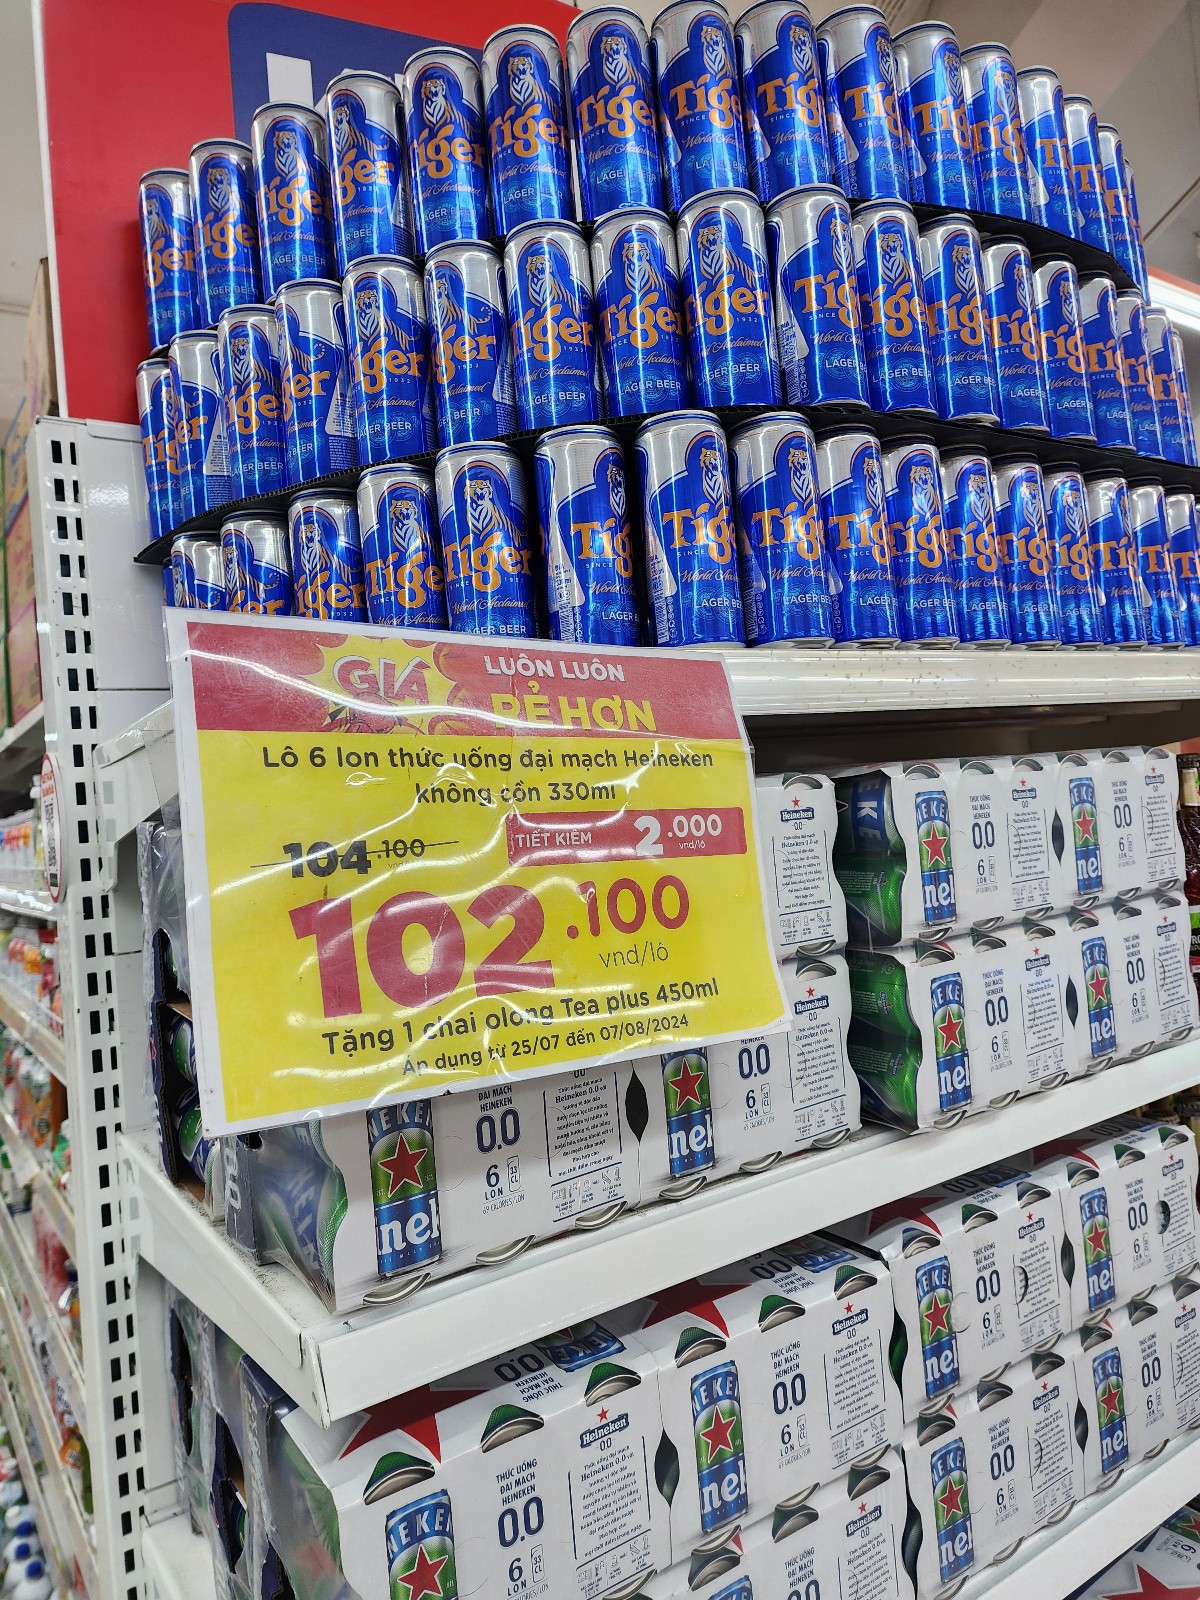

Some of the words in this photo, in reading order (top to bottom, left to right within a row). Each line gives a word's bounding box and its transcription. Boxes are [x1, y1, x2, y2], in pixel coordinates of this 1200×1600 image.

[757, 73, 824, 128] Tig
[844, 83, 901, 140] Tig
[681, 114, 707, 127] SINCE
[913, 99, 973, 149] Tig
[412, 125, 486, 179] iger
[970, 114, 1025, 164] Tig
[335, 150, 395, 204] ger
[503, 190, 535, 205] LAGER
[143, 238, 196, 287] ger
[301, 254, 326, 267] BEER
[795, 270, 859, 328] Tig
[929, 295, 989, 345] Tig
[990, 309, 1040, 360] Tig
[433, 324, 496, 384] ger
[1040, 323, 1084, 373] Tig
[353, 341, 426, 393] iger
[732, 363, 760, 374] BEER
[825, 357, 855, 368] LAGER
[872, 368, 905, 382] LAGER
[621, 380, 653, 395] LAGER
[656, 380, 681, 390] BEER
[950, 375, 982, 387] LAGER
[558, 391, 586, 402] BEER
[384, 421, 412, 432] BEER
[455, 407, 480, 421] BEER
[292, 443, 313, 457] BEER
[256, 461, 284, 472] BEER
[663, 502, 735, 563] Tig
[752, 502, 822, 560] Tig
[828, 509, 887, 564] Tig
[570, 517, 632, 577] Tig
[677, 548, 705, 557] SINCE
[950, 521, 997, 572] Tig
[1000, 526, 1050, 576] Tig
[445, 532, 532, 592] Tiger
[366, 553, 445, 609] Tige
[296, 570, 366, 619] iger
[694, 597, 728, 609] LAGER
[784, 594, 818, 605] LAGER
[860, 596, 889, 606] LAGER
[905, 599, 938, 610] LAGER
[966, 601, 997, 611] LAGER
[602, 611, 633, 621] LAGER
[1018, 603, 1050, 614] LAGER
[499, 624, 526, 635] BEER
[333, 655, 430, 702] GIÁ
[484, 654, 554, 677] LUÔN
[561, 658, 625, 682] LUÔN
[491, 681, 553, 728] RẺ
[557, 694, 657, 731] HƠN
[262, 746, 299, 767] Lô
[309, 746, 326, 767] 6
[337, 746, 379, 767] lon
[387, 746, 444, 767] thức
[453, 746, 512, 771] uống
[519, 749, 553, 772] đại
[561, 750, 618, 771] mạch
[624, 750, 713, 767] Heineken
[415, 782, 492, 807] không
[500, 779, 541, 803] cồn
[549, 781, 616, 801] 330ml
[782, 809, 814, 821] Heineken
[1113, 803, 1133, 829] 0.0
[515, 828, 551, 848] TIẾT
[971, 821, 996, 851] 0.0
[1118, 836, 1126, 851] 6
[977, 859, 985, 876] 6
[599, 941, 670, 969] vnd/lô
[1126, 957, 1145, 985] 0.0
[322, 1028, 394, 1058] Tặng
[402, 1020, 413, 1042] 1
[423, 1011, 477, 1040] chai
[485, 1004, 554, 1029] olong
[560, 998, 599, 1018] Tea
[606, 990, 650, 1015] plus
[656, 977, 719, 1003] 450ml
[795, 998, 828, 1013] Heineken
[985, 995, 1009, 1027] 0.0
[402, 1055, 429, 1076] Áp
[434, 1049, 483, 1071] dụng
[488, 1043, 506, 1060] từ
[511, 1033, 559, 1057] 25/07
[565, 1027, 596, 1048] đến
[600, 1013, 689, 1042] 07/08/2024
[991, 1036, 999, 1052] 6
[737, 1043, 771, 1079] 0.0
[480, 1096, 513, 1113] HEINEKEN
[745, 1089, 756, 1109] 6
[744, 1109, 759, 1120] LON
[476, 1107, 521, 1153] 0.0
[485, 1164, 500, 1188] 6
[510, 1165, 518, 1175] 33
[511, 1175, 519, 1184] CL
[484, 1186, 504, 1201] LON
[976, 1269, 1001, 1304] 0.0
[833, 1310, 868, 1333] Heineken
[982, 1311, 991, 1329] 6
[773, 1373, 807, 1415] 0.0
[583, 1416, 627, 1446] Heineken
[781, 1423, 792, 1445] 6
[780, 1443, 795, 1457] LON
[990, 1444, 1015, 1481] 0.0
[502, 1483, 536, 1507] HEINEKEN
[996, 1488, 1005, 1505] 6
[497, 1496, 545, 1548] 0.0
[848, 1507, 881, 1534] Heineken
[508, 1557, 523, 1583] 6
[507, 1579, 527, 1597] LON
